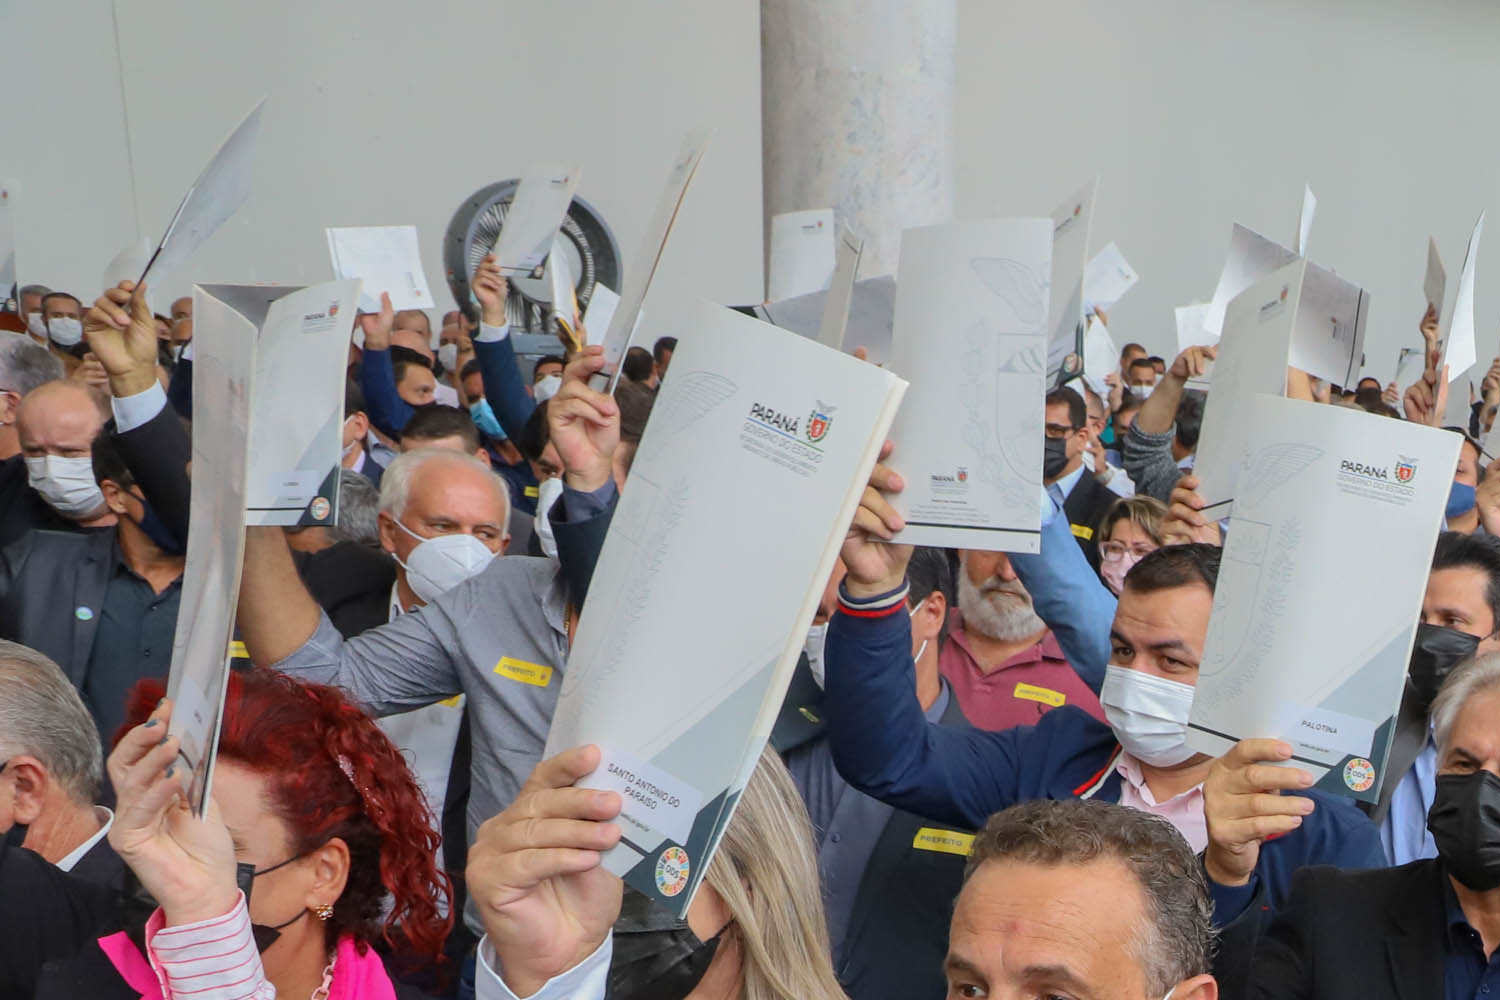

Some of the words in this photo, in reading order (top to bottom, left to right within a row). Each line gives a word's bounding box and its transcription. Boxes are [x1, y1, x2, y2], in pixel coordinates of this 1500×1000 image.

[750, 402, 801, 435] PARANÁ
[1340, 459, 1388, 479] PARANÁ
[1301, 720, 1338, 735] PALOTINA
[607, 763, 636, 784] SANTO
[635, 777, 669, 801] ANTONIO
[667, 796, 681, 808] DO
[623, 786, 658, 810] PARAISO
[664, 864, 680, 879] ODS
